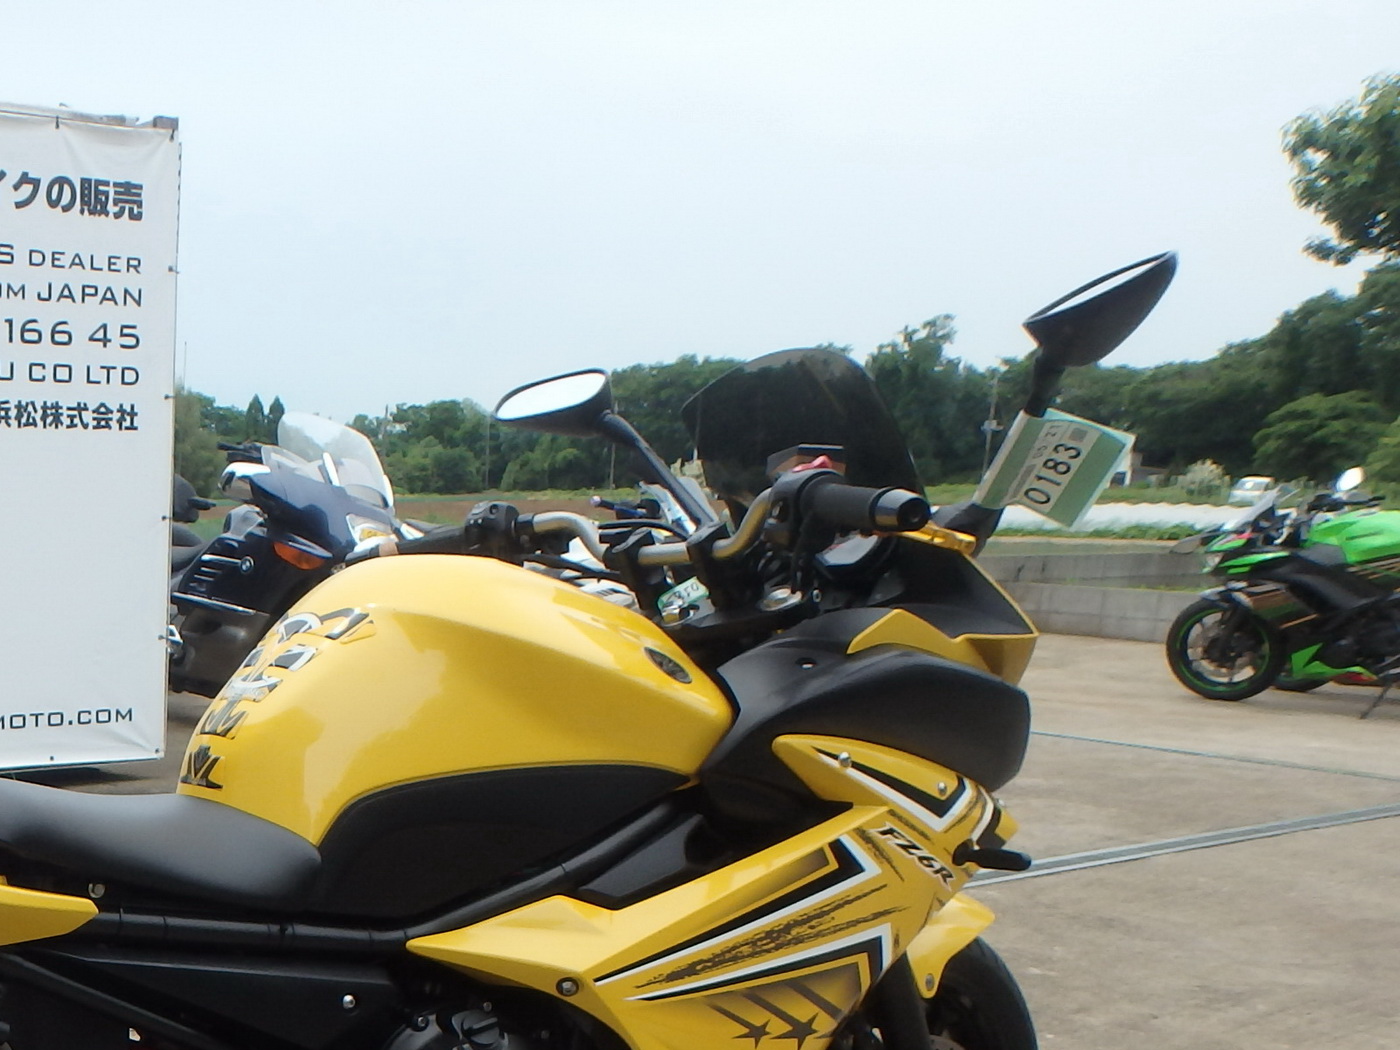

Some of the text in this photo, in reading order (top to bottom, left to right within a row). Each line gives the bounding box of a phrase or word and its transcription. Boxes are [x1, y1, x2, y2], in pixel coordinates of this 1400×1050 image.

[28, 248, 141, 274] DEALER
[37, 282, 142, 307] JAPAN
[4, 318, 73, 346] 166
[87, 322, 141, 350] 45
[28, 362, 73, 383] CO
[86, 364, 140, 386] LTD
[1023, 443, 1082, 505] 0183
[874, 823, 954, 890] FZ6R
